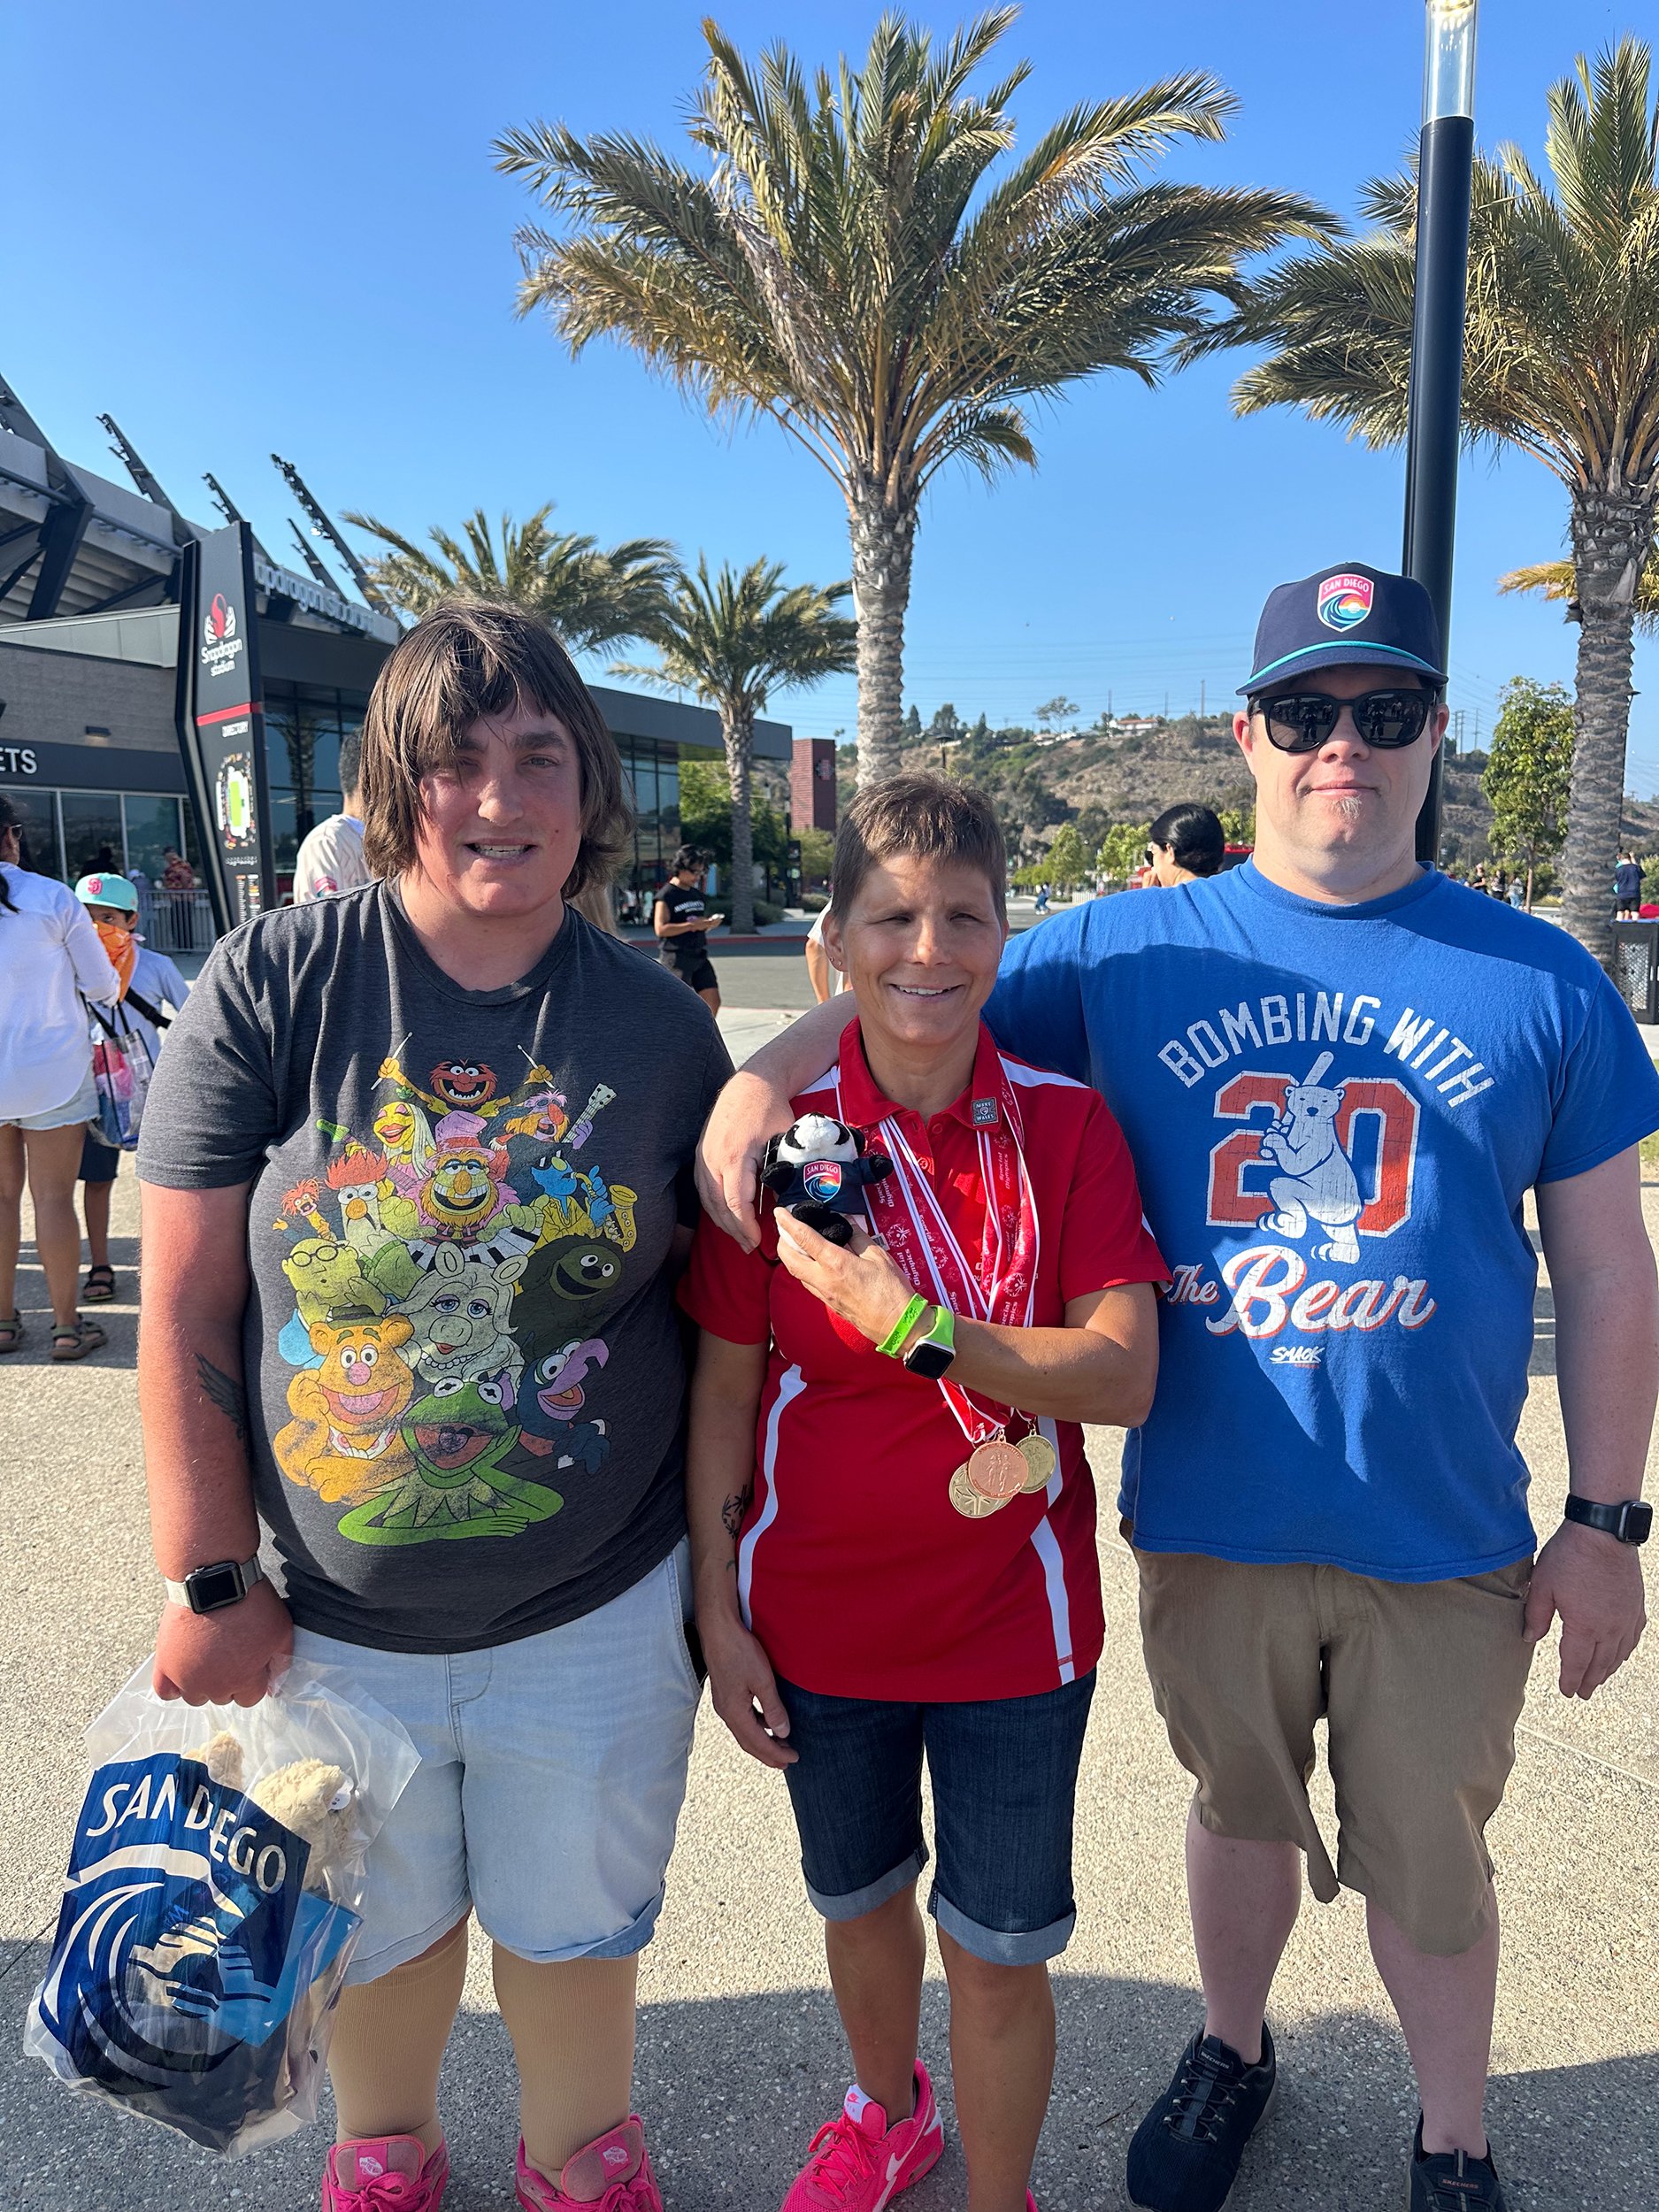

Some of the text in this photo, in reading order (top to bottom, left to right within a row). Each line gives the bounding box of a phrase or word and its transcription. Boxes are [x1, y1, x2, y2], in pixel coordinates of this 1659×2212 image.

[1324, 578, 1369, 595] SAN DIEGO
[1157, 991, 1495, 1108] BOMBING WITH
[1205, 1070, 1422, 1238] 20
[807, 1164, 839, 1175] SAN DIEGO
[877, 1183, 886, 1204] Speci
[905, 1248, 921, 1286] Olympics
[949, 1291, 962, 1315] Speci
[1168, 1244, 1438, 1339] The Bear
[1270, 1346, 1325, 1363] SMACK
[86, 1774, 176, 1837] SAN
[1442, 2178, 1479, 2189] SKECHERS
